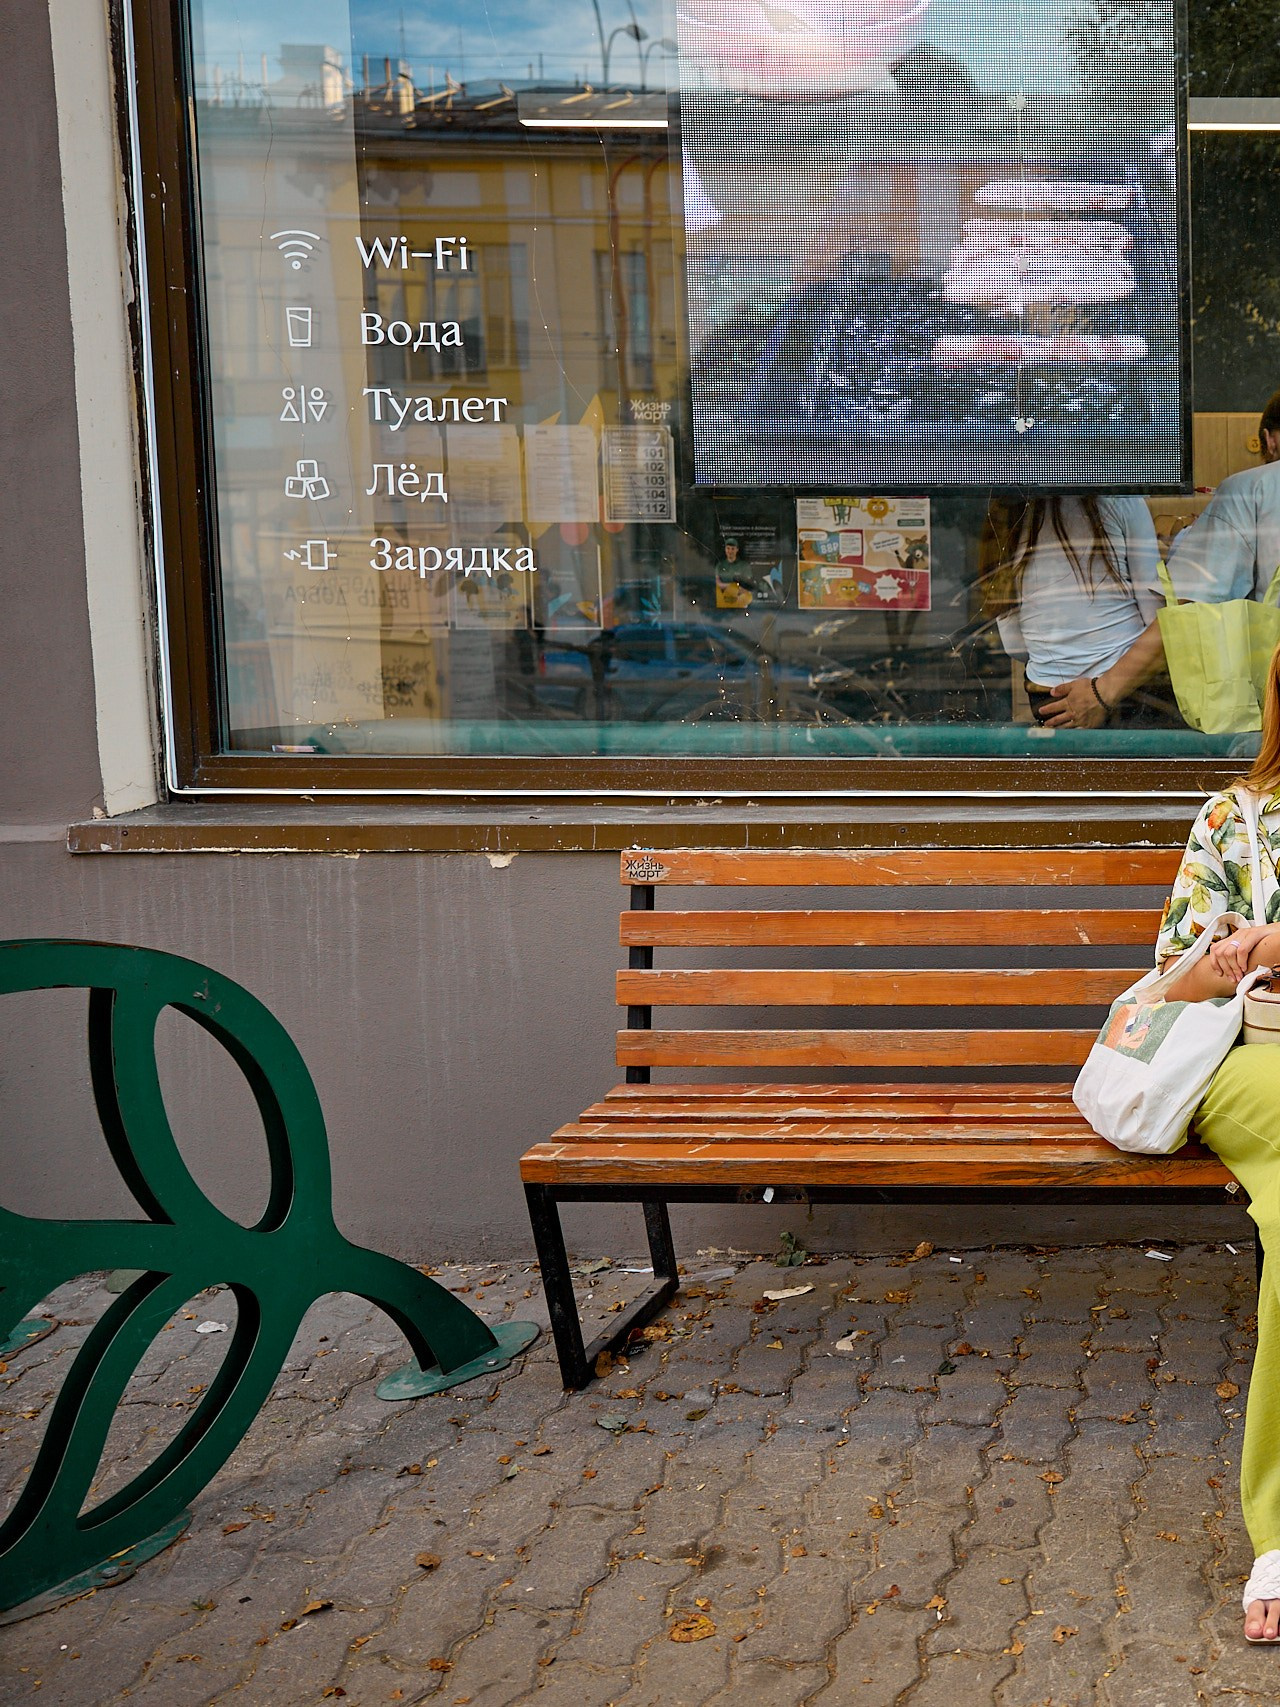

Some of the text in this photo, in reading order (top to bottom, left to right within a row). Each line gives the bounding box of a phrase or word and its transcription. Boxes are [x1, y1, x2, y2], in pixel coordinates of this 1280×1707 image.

[355, 236, 468, 270] Wi-Fi
[360, 312, 464, 353] Вода
[362, 387, 508, 432] Туалет
[630, 399, 672, 411] Жизнь
[634, 411, 668, 423] март
[644, 448, 664, 458] 101
[644, 462, 665, 472] 102
[366, 463, 448, 503] Лёд
[645, 476, 665, 486] 103
[645, 489, 666, 499] 104
[645, 503, 667, 513] 112
[369, 537, 538, 579] Зарядка
[625, 859, 664, 870] Жизнь
[629, 870, 660, 880] март
